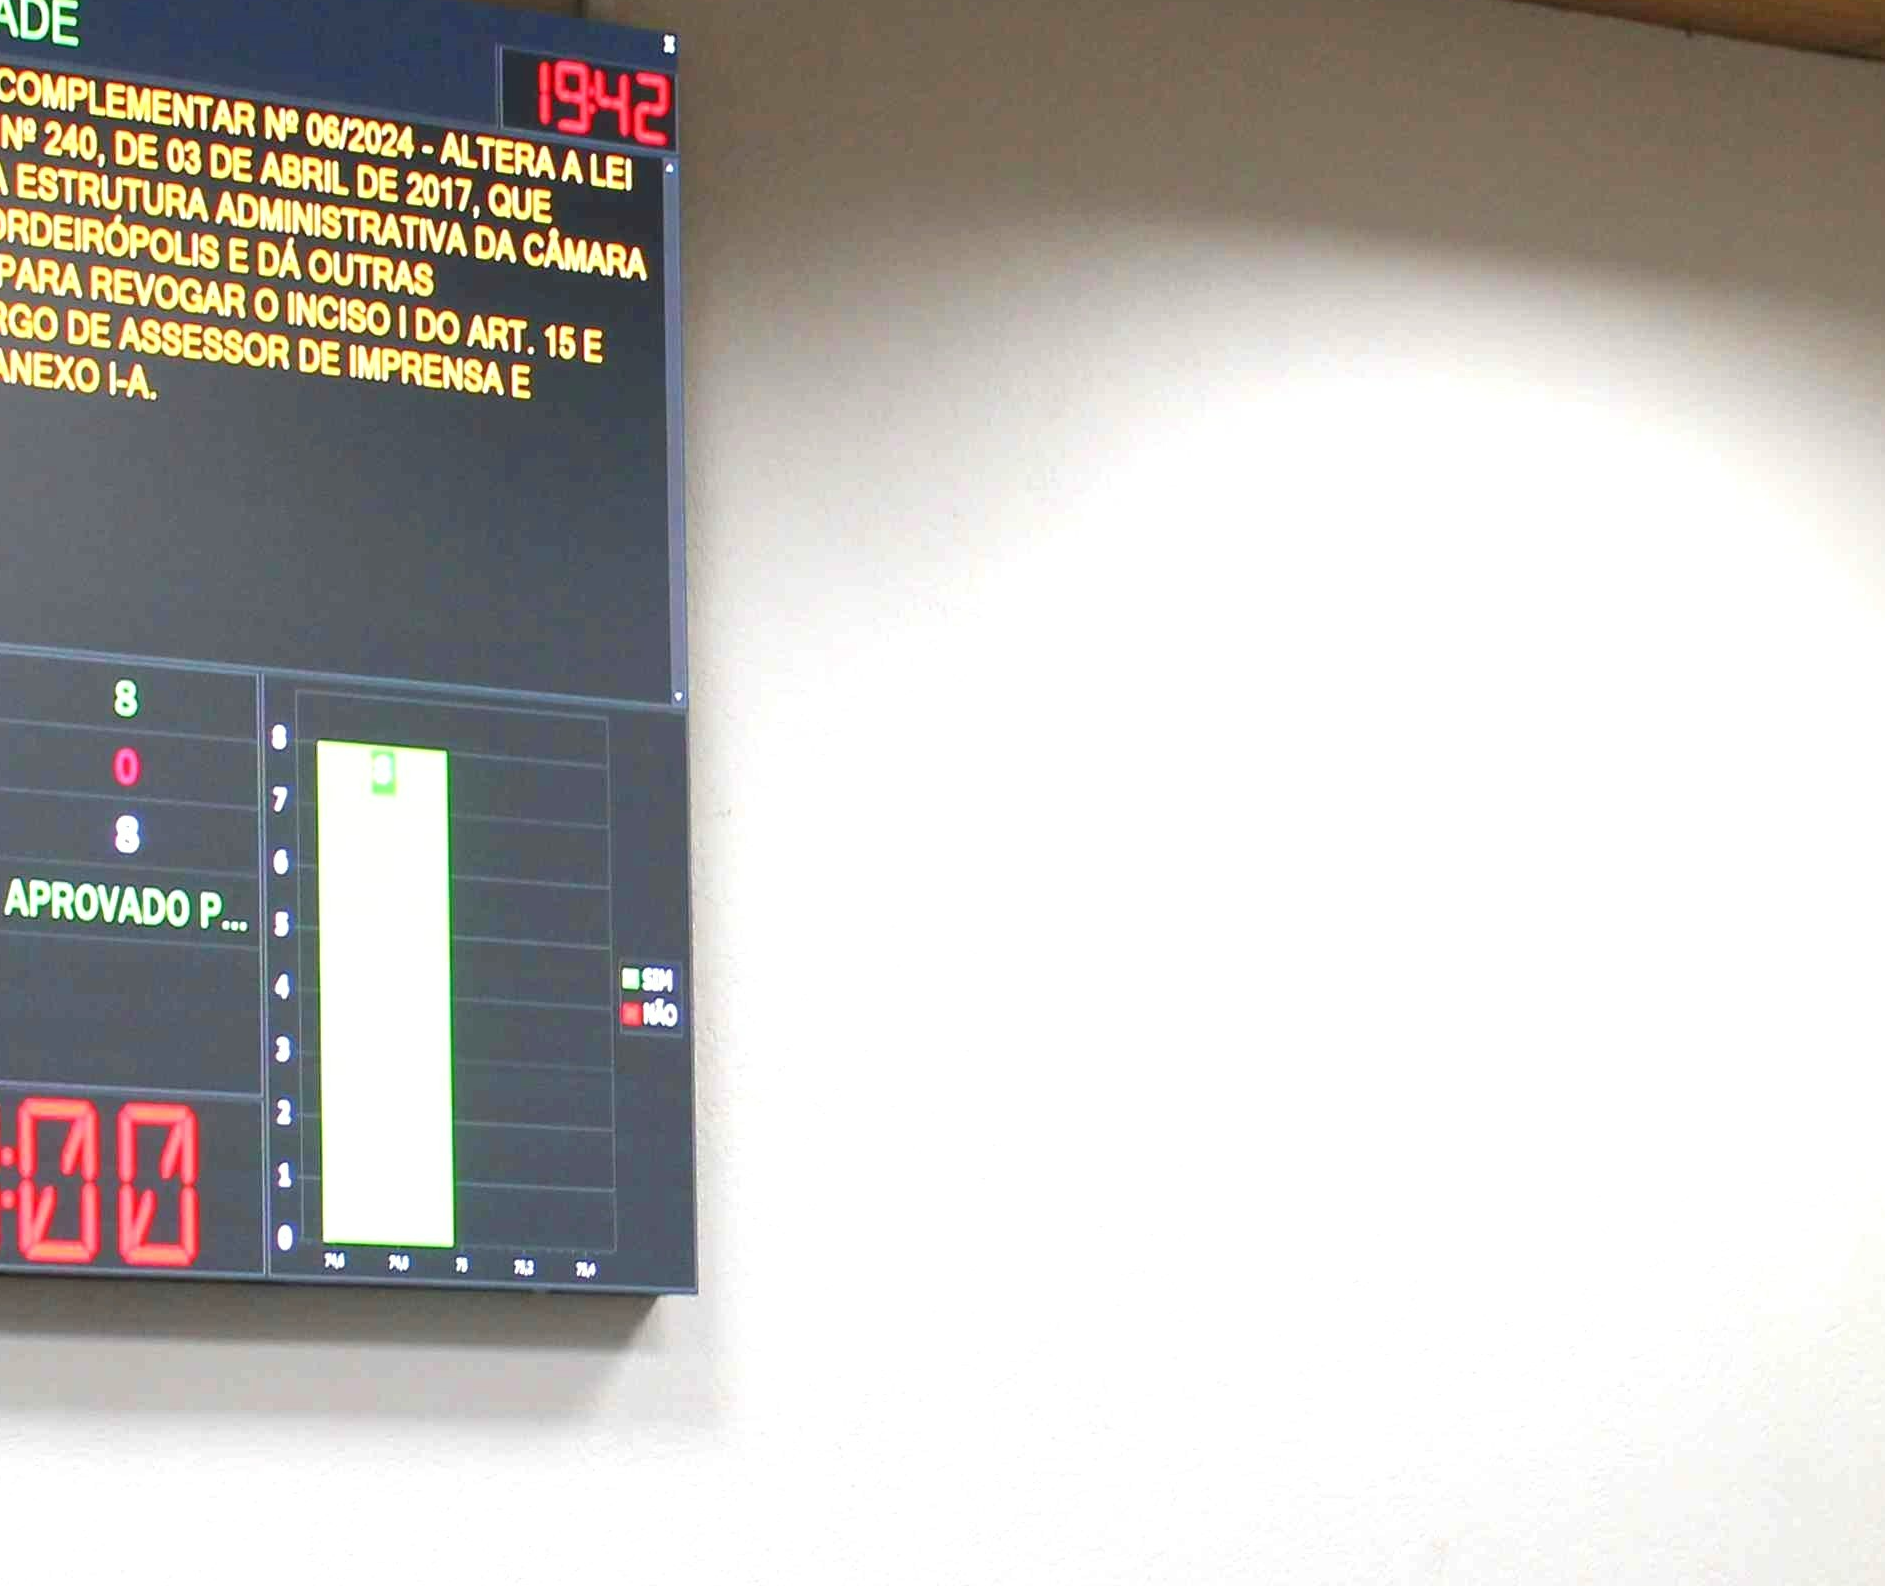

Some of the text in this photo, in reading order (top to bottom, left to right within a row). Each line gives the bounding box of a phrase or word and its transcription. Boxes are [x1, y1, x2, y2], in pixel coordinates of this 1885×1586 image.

[538, 60, 672, 146] 19:42
[306, 113, 414, 159] 06/2024
[440, 132, 556, 180] ALTERA
[561, 150, 583, 184] A
[590, 154, 632, 191] LEI
[44, 121, 105, 168] 240,
[115, 130, 158, 170] DE
[167, 138, 202, 175] 03
[210, 144, 252, 183] DE
[260, 152, 349, 196] ABRIL
[357, 164, 398, 202] DE
[406, 172, 480, 219] 2017,
[489, 184, 552, 224] QUE
[17, 163, 209, 222] ESTRUTURA
[215, 191, 467, 257] ADMINISTRATIVA
[475, 225, 517, 263] DA
[523, 228, 647, 281] CÂMARA
[229, 238, 249, 273] E
[258, 237, 301, 280] DÁ
[308, 249, 434, 297] OUTRAS
[91, 266, 246, 319] REVOGAR
[254, 288, 279, 322] O
[288, 291, 391, 336] INCISO
[416, 308, 460, 345] DO
[467, 315, 534, 355] ART.
[545, 325, 576, 359] 15
[584, 329, 602, 363] E
[68, 309, 111, 348] DE
[118, 317, 290, 370] ASSESSOR
[299, 338, 341, 376] DE
[350, 344, 504, 395] IMPRENSA
[512, 365, 531, 399] E
[109, 361, 157, 400] I-A.
[115, 680, 137, 716] 8
[113, 746, 143, 788] 0
[273, 786, 288, 811] 7
[115, 815, 143, 853] 8
[273, 849, 289, 874] 6
[4, 879, 190, 927] APROVADO
[274, 912, 293, 936] 5
[275, 974, 293, 999] 4
[641, 967, 674, 992] SIM
[642, 997, 678, 1027] NÃO
[276, 1036, 293, 1062] 3
[277, 1099, 295, 1125] 2
[278, 1162, 294, 1187] 1
[278, 1225, 297, 1251] 0
